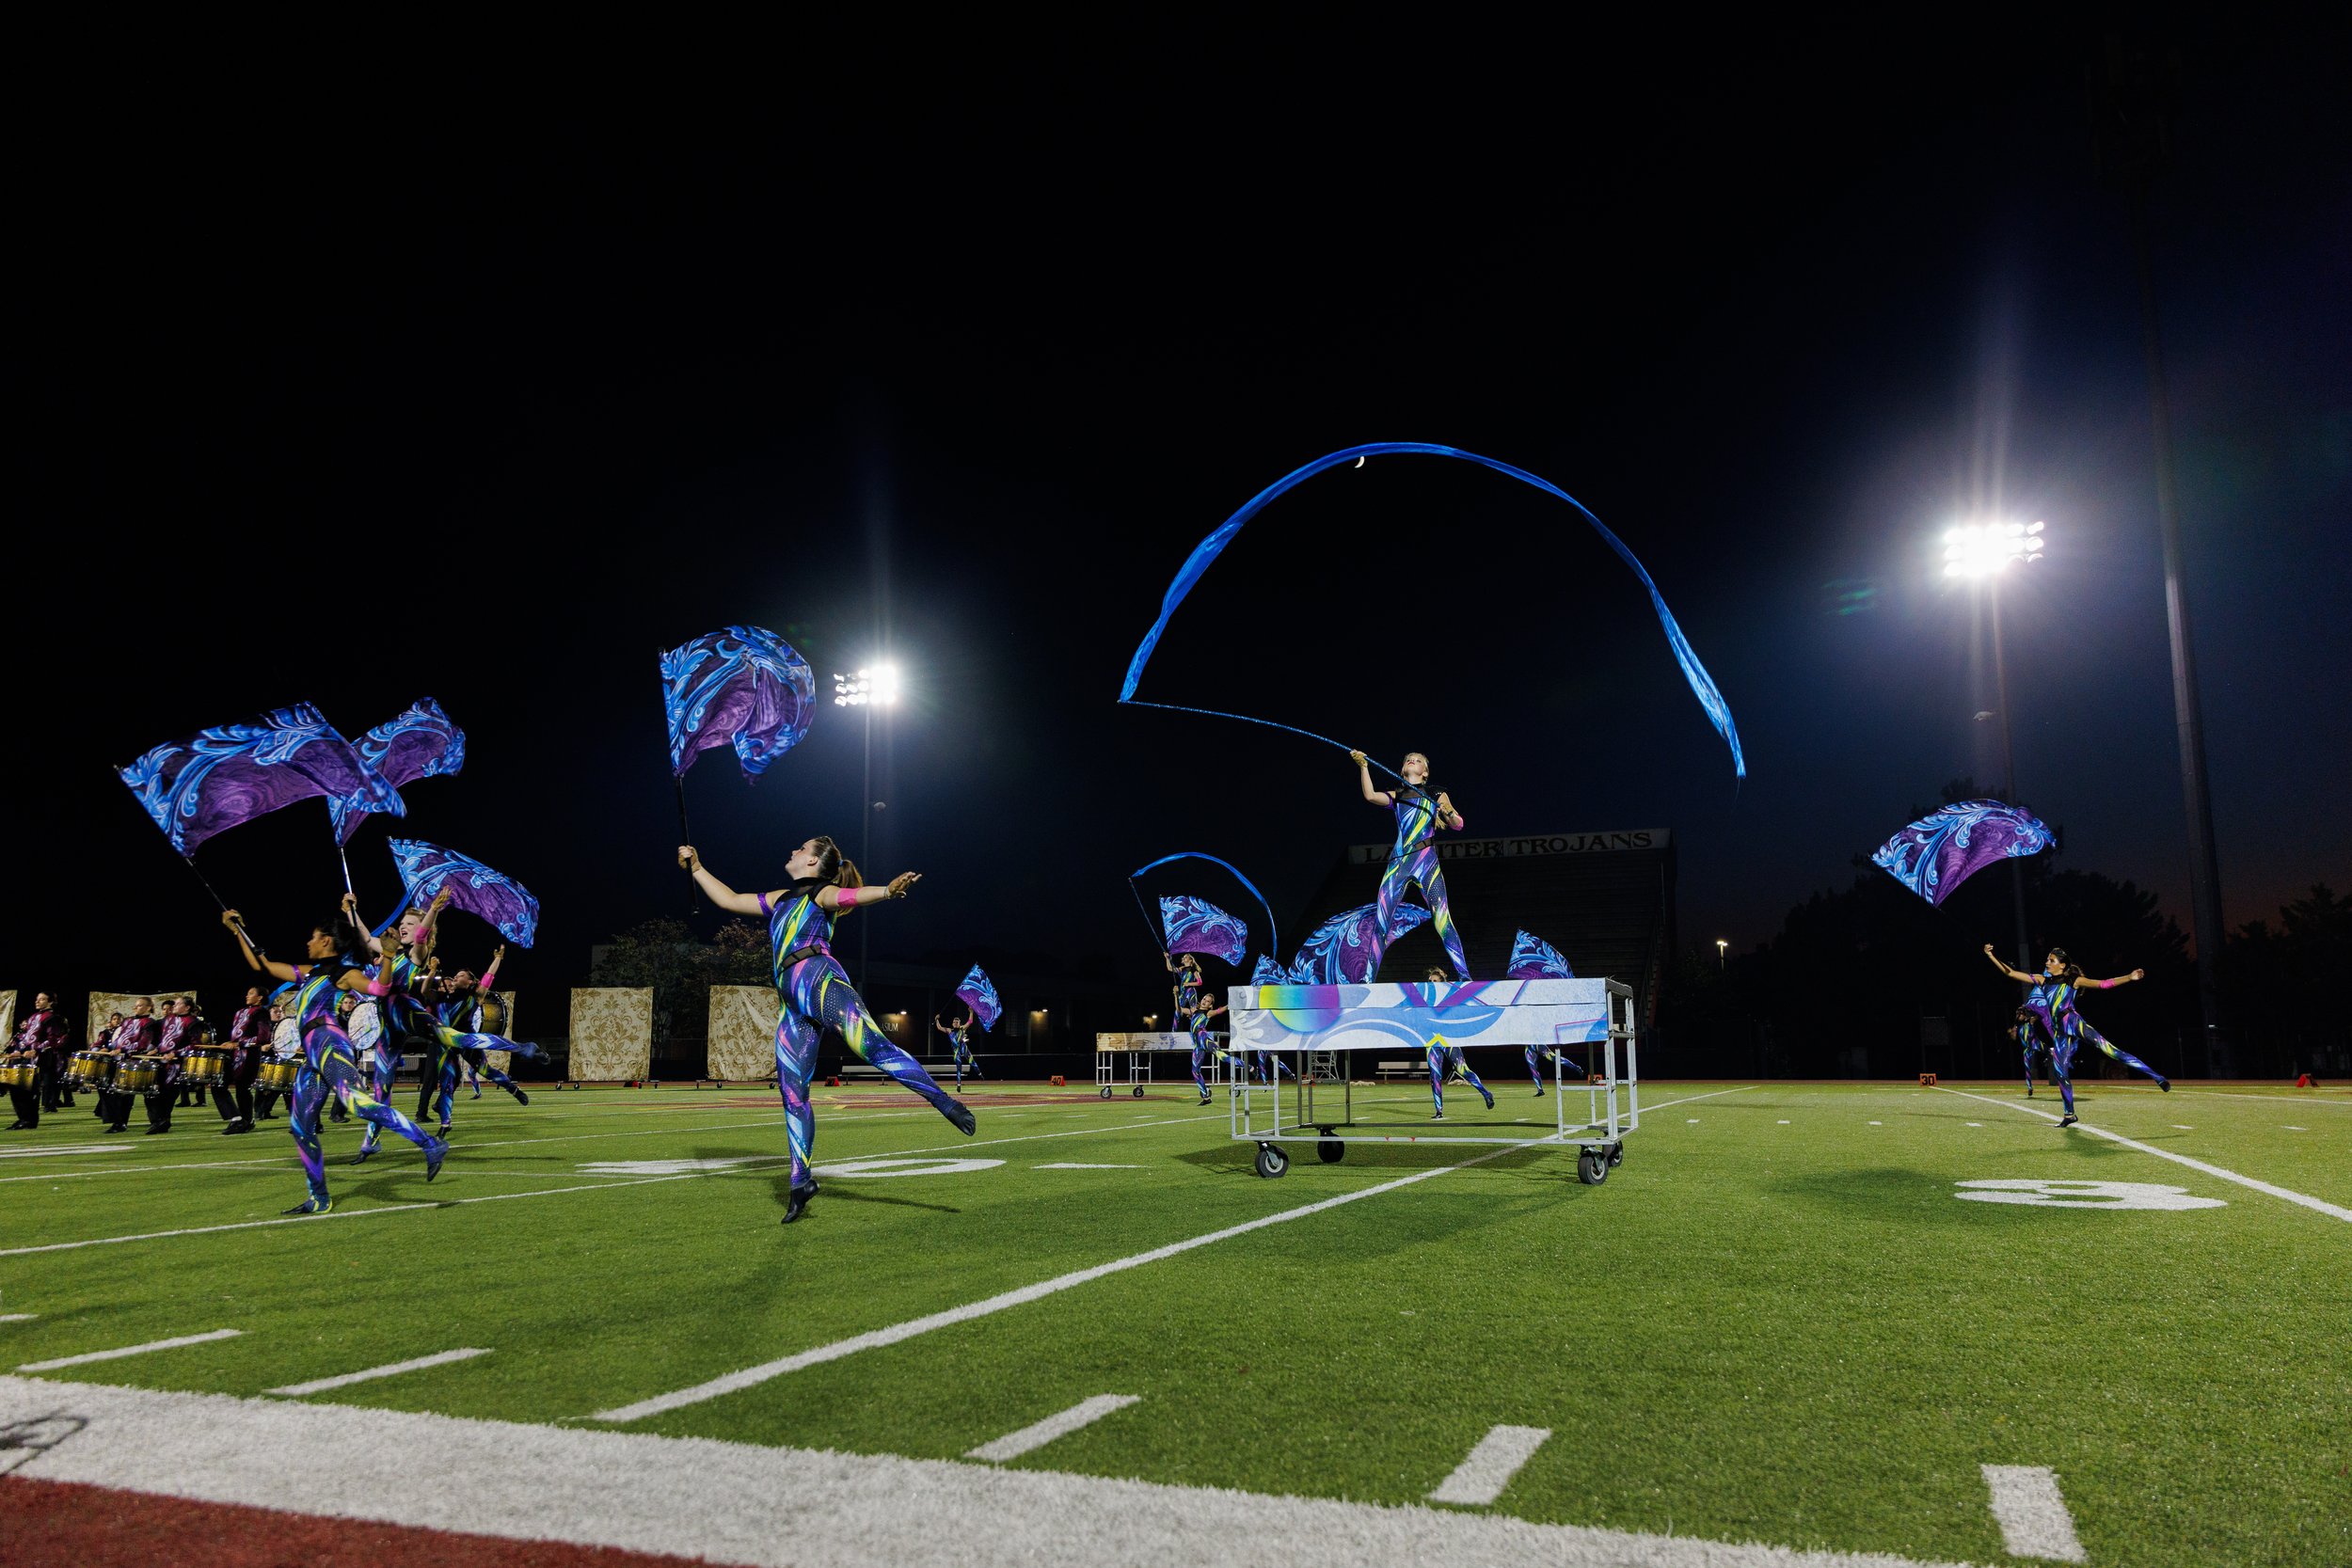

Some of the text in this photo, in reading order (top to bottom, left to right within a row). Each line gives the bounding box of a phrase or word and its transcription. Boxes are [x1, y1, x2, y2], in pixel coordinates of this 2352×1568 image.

[1511, 832, 1652, 855] TROJANS
[1051, 1075, 1061, 1085] 40
[1921, 1075, 1935, 1085] 30
